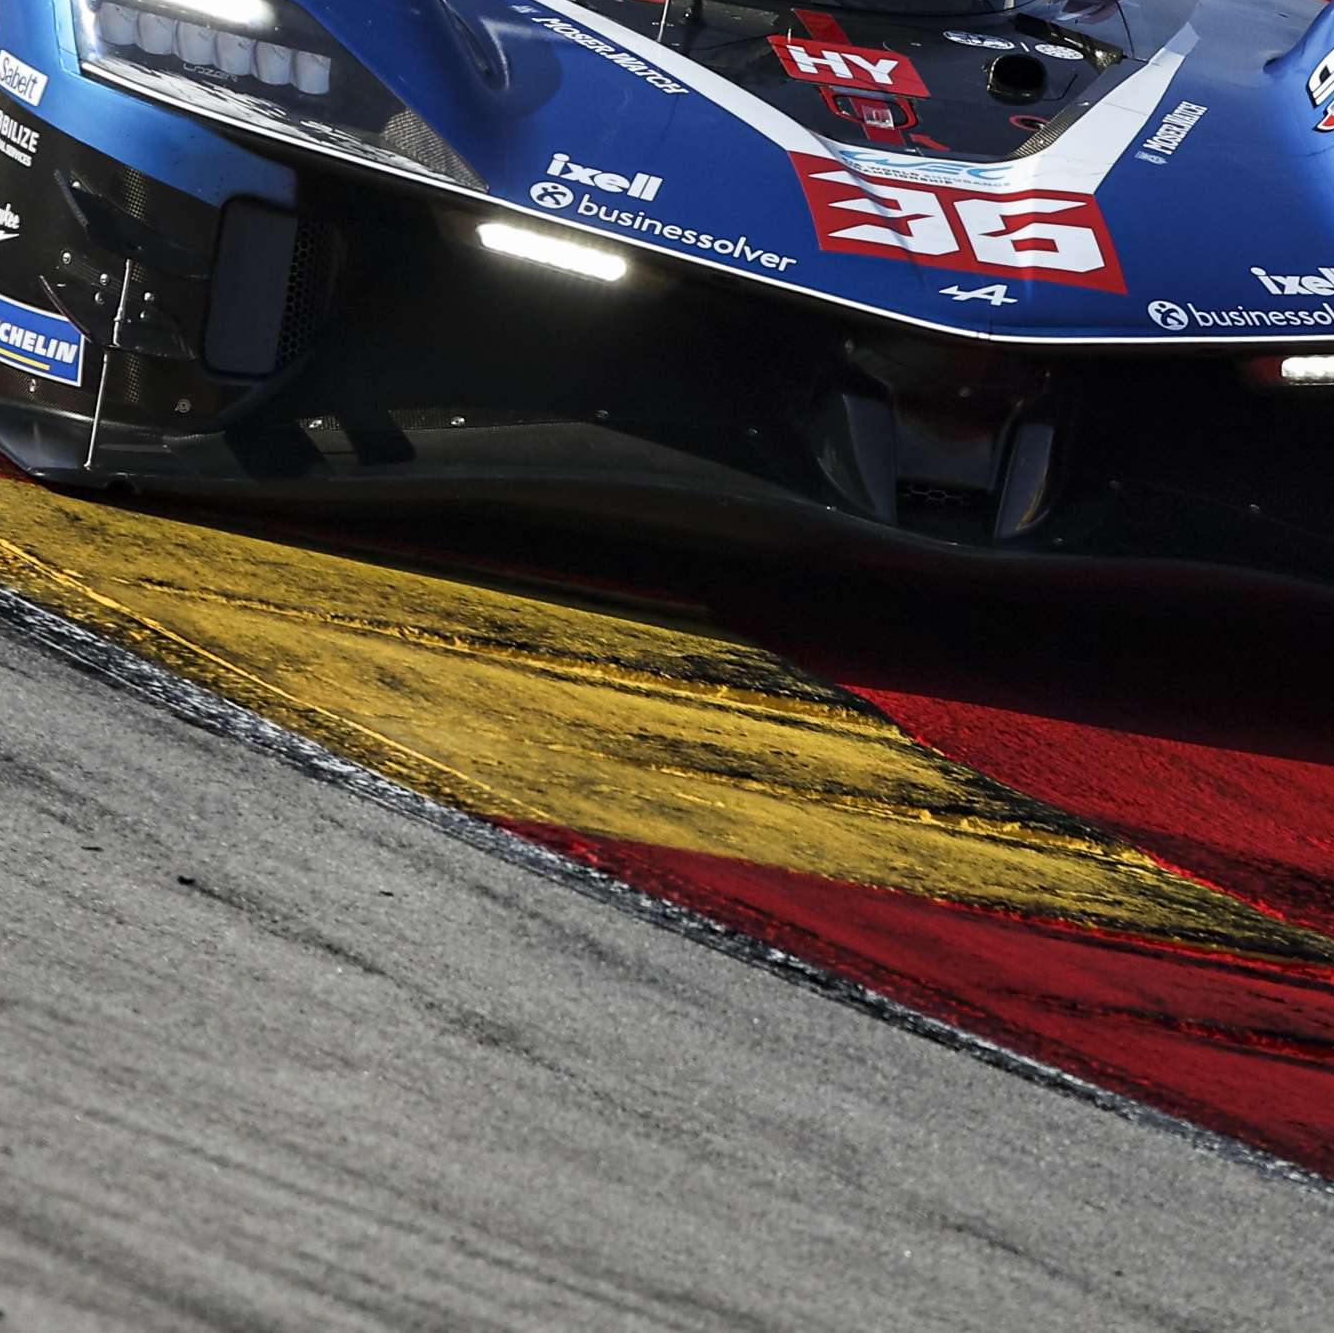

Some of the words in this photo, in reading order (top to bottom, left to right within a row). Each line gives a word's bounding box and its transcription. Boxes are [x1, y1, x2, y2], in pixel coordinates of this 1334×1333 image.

[0, 57, 38, 99] Sabelt
[531, 17, 690, 94] MOSER.WATCH
[782, 45, 902, 85] HY
[1143, 100, 1208, 155] MOSER.WATCH
[547, 153, 663, 202] ixell
[924, 173, 1012, 188] ENDURANCE
[578, 193, 797, 272] businessolver
[807, 170, 1105, 273] 36
